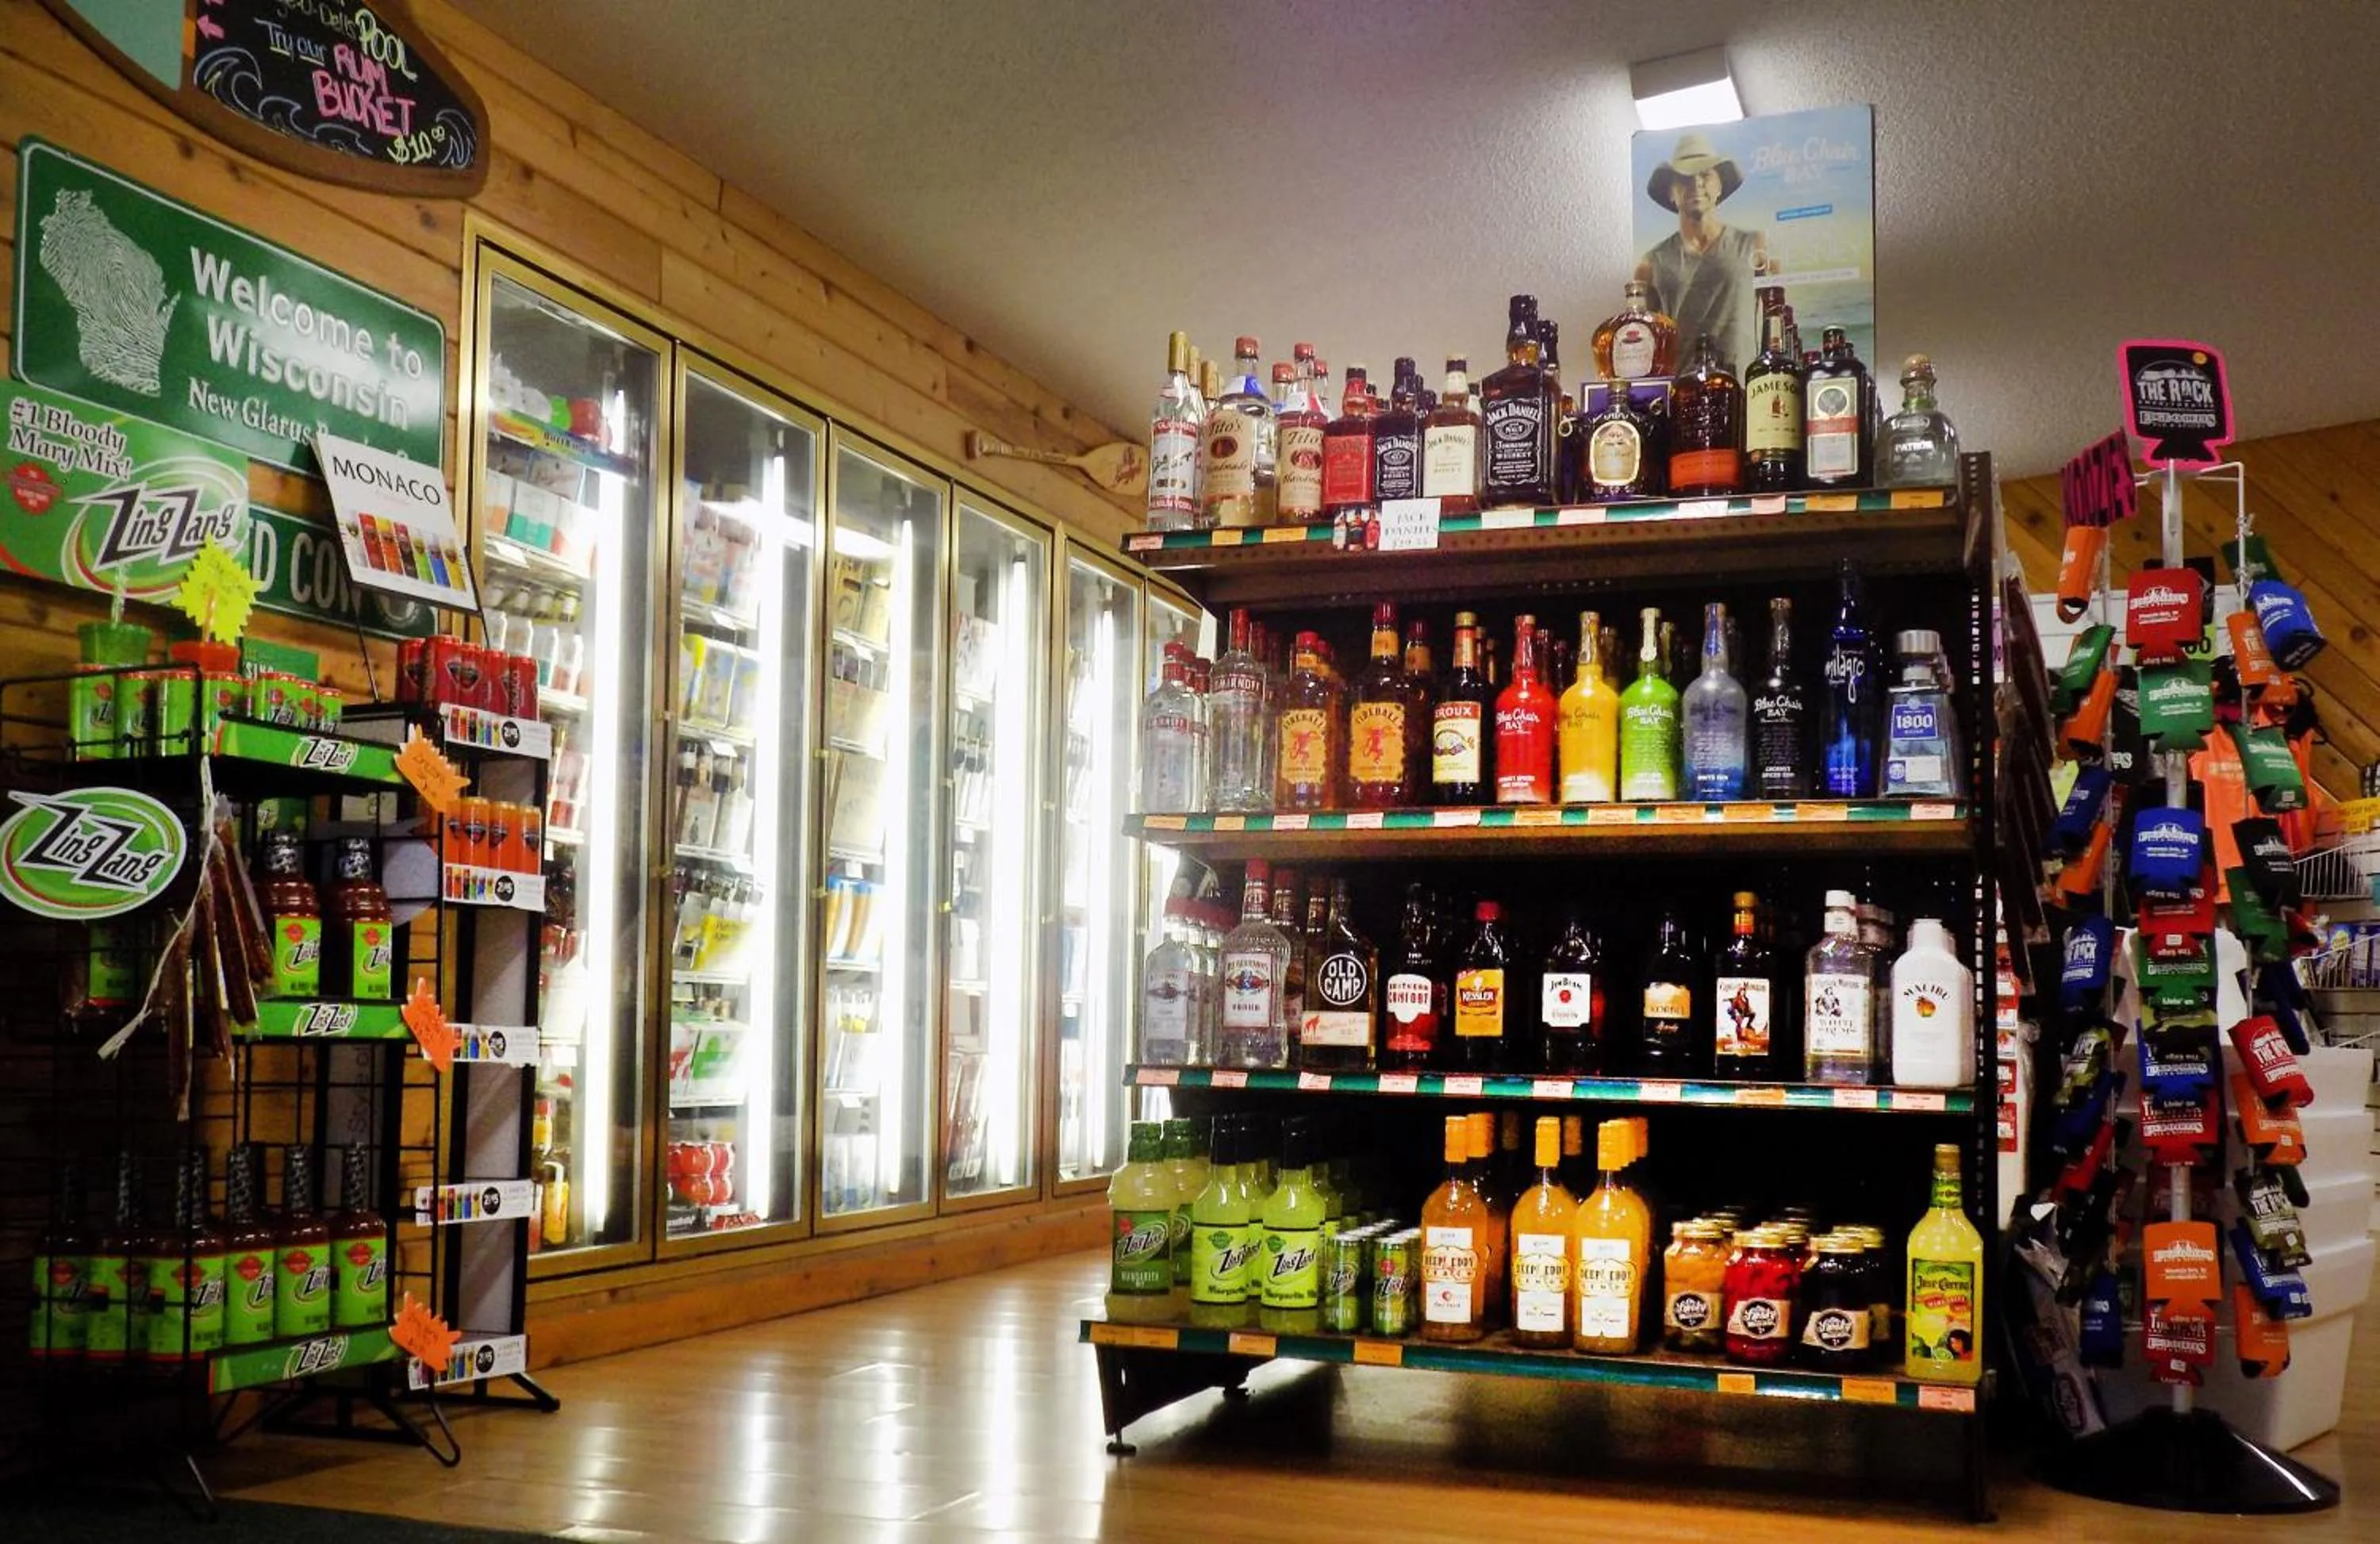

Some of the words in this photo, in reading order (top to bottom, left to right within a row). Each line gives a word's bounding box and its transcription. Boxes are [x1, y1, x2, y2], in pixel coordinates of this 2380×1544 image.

[254, 17, 294, 62] Try
[297, 36, 327, 63] our
[355, 9, 418, 82] POOL
[333, 44, 389, 96] RUM
[313, 70, 416, 136] BUCKET
[190, 245, 374, 360] Welcome
[386, 331, 424, 378] to
[206, 313, 409, 432] Wisconsin
[1751, 381, 1798, 398] JAMESO
[2136, 379, 2167, 401] THE
[10, 398, 39, 428] #1
[46, 406, 125, 451] Bloody
[188, 377, 236, 420] New
[241, 401, 311, 446] Glarus
[1486, 405, 1508, 426] JACK
[10, 428, 75, 471] Mary
[81, 447, 131, 479] Mix!
[1287, 431, 1323, 445] Tito'
[332, 455, 442, 506] MONACO
[1825, 643, 1865, 705] milagro
[1895, 713, 1933, 729] 1800
[1324, 977, 1361, 1001] CAMP
[1327, 959, 1357, 977] OLD
